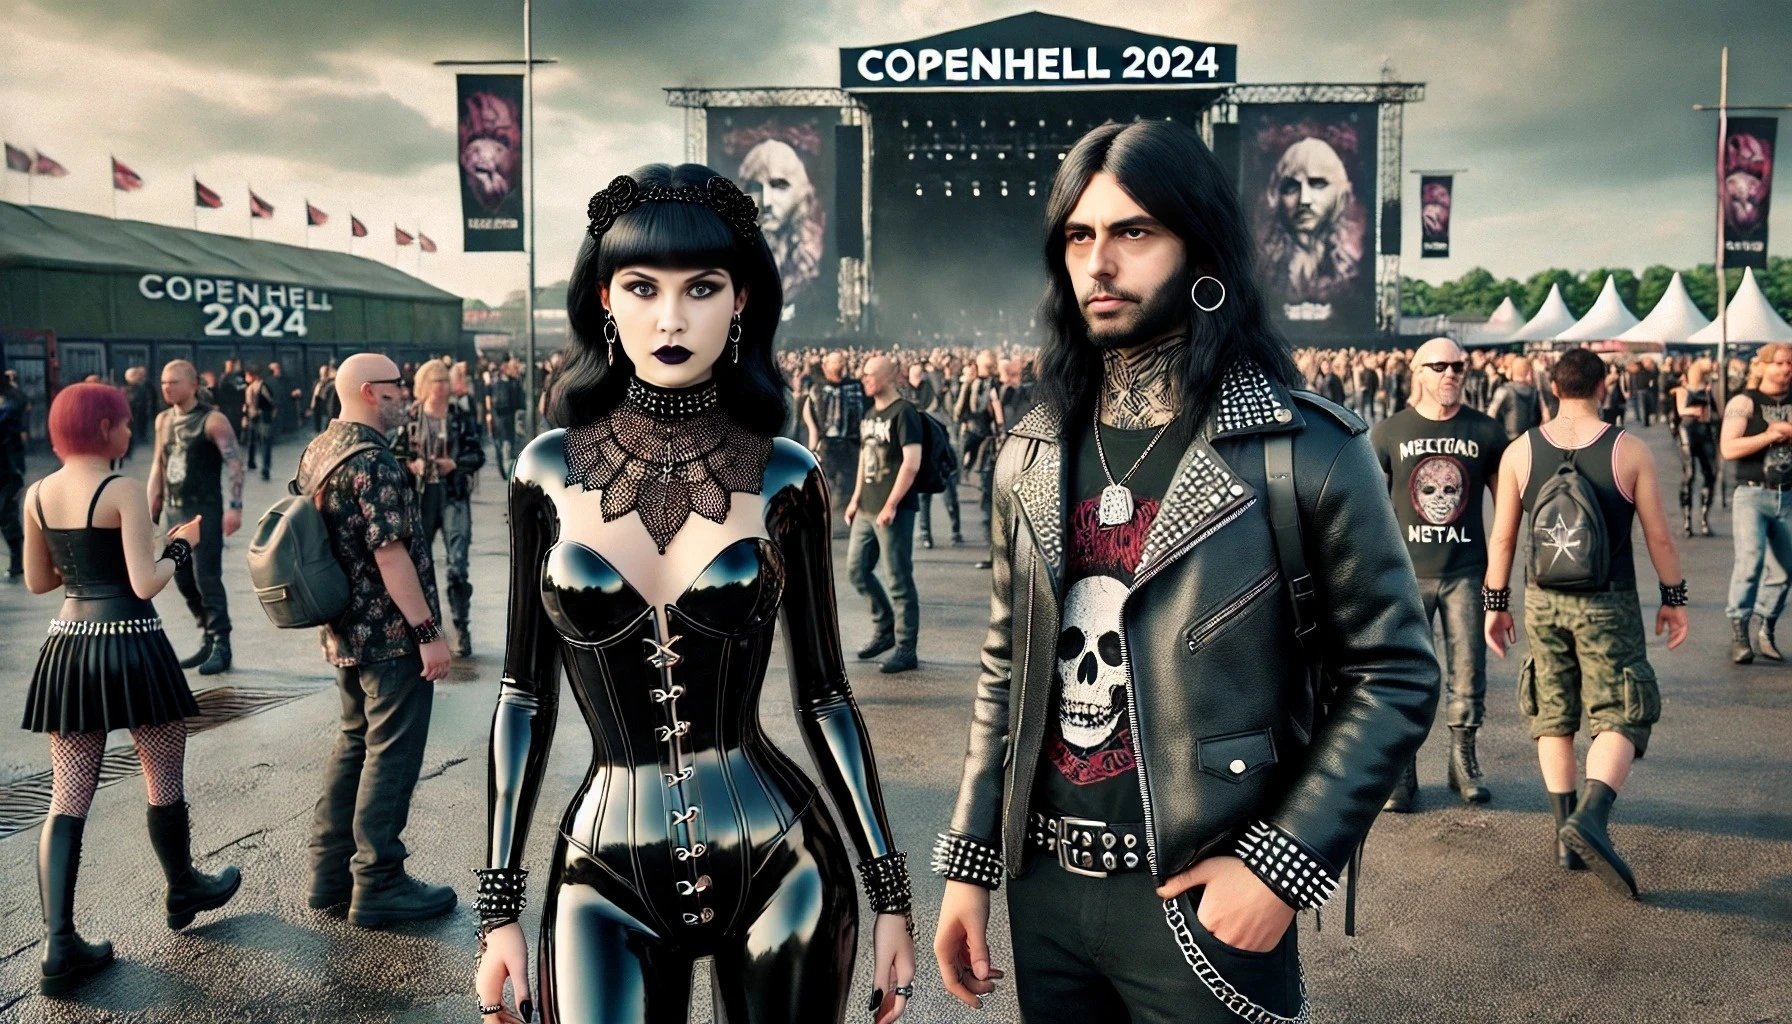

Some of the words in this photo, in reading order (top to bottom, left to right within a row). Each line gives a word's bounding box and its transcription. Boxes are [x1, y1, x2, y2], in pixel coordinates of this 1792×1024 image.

[857, 47, 1110, 82] COPENHELL
[1122, 46, 1219, 79] 2024
[203, 303, 307, 337] 2024
